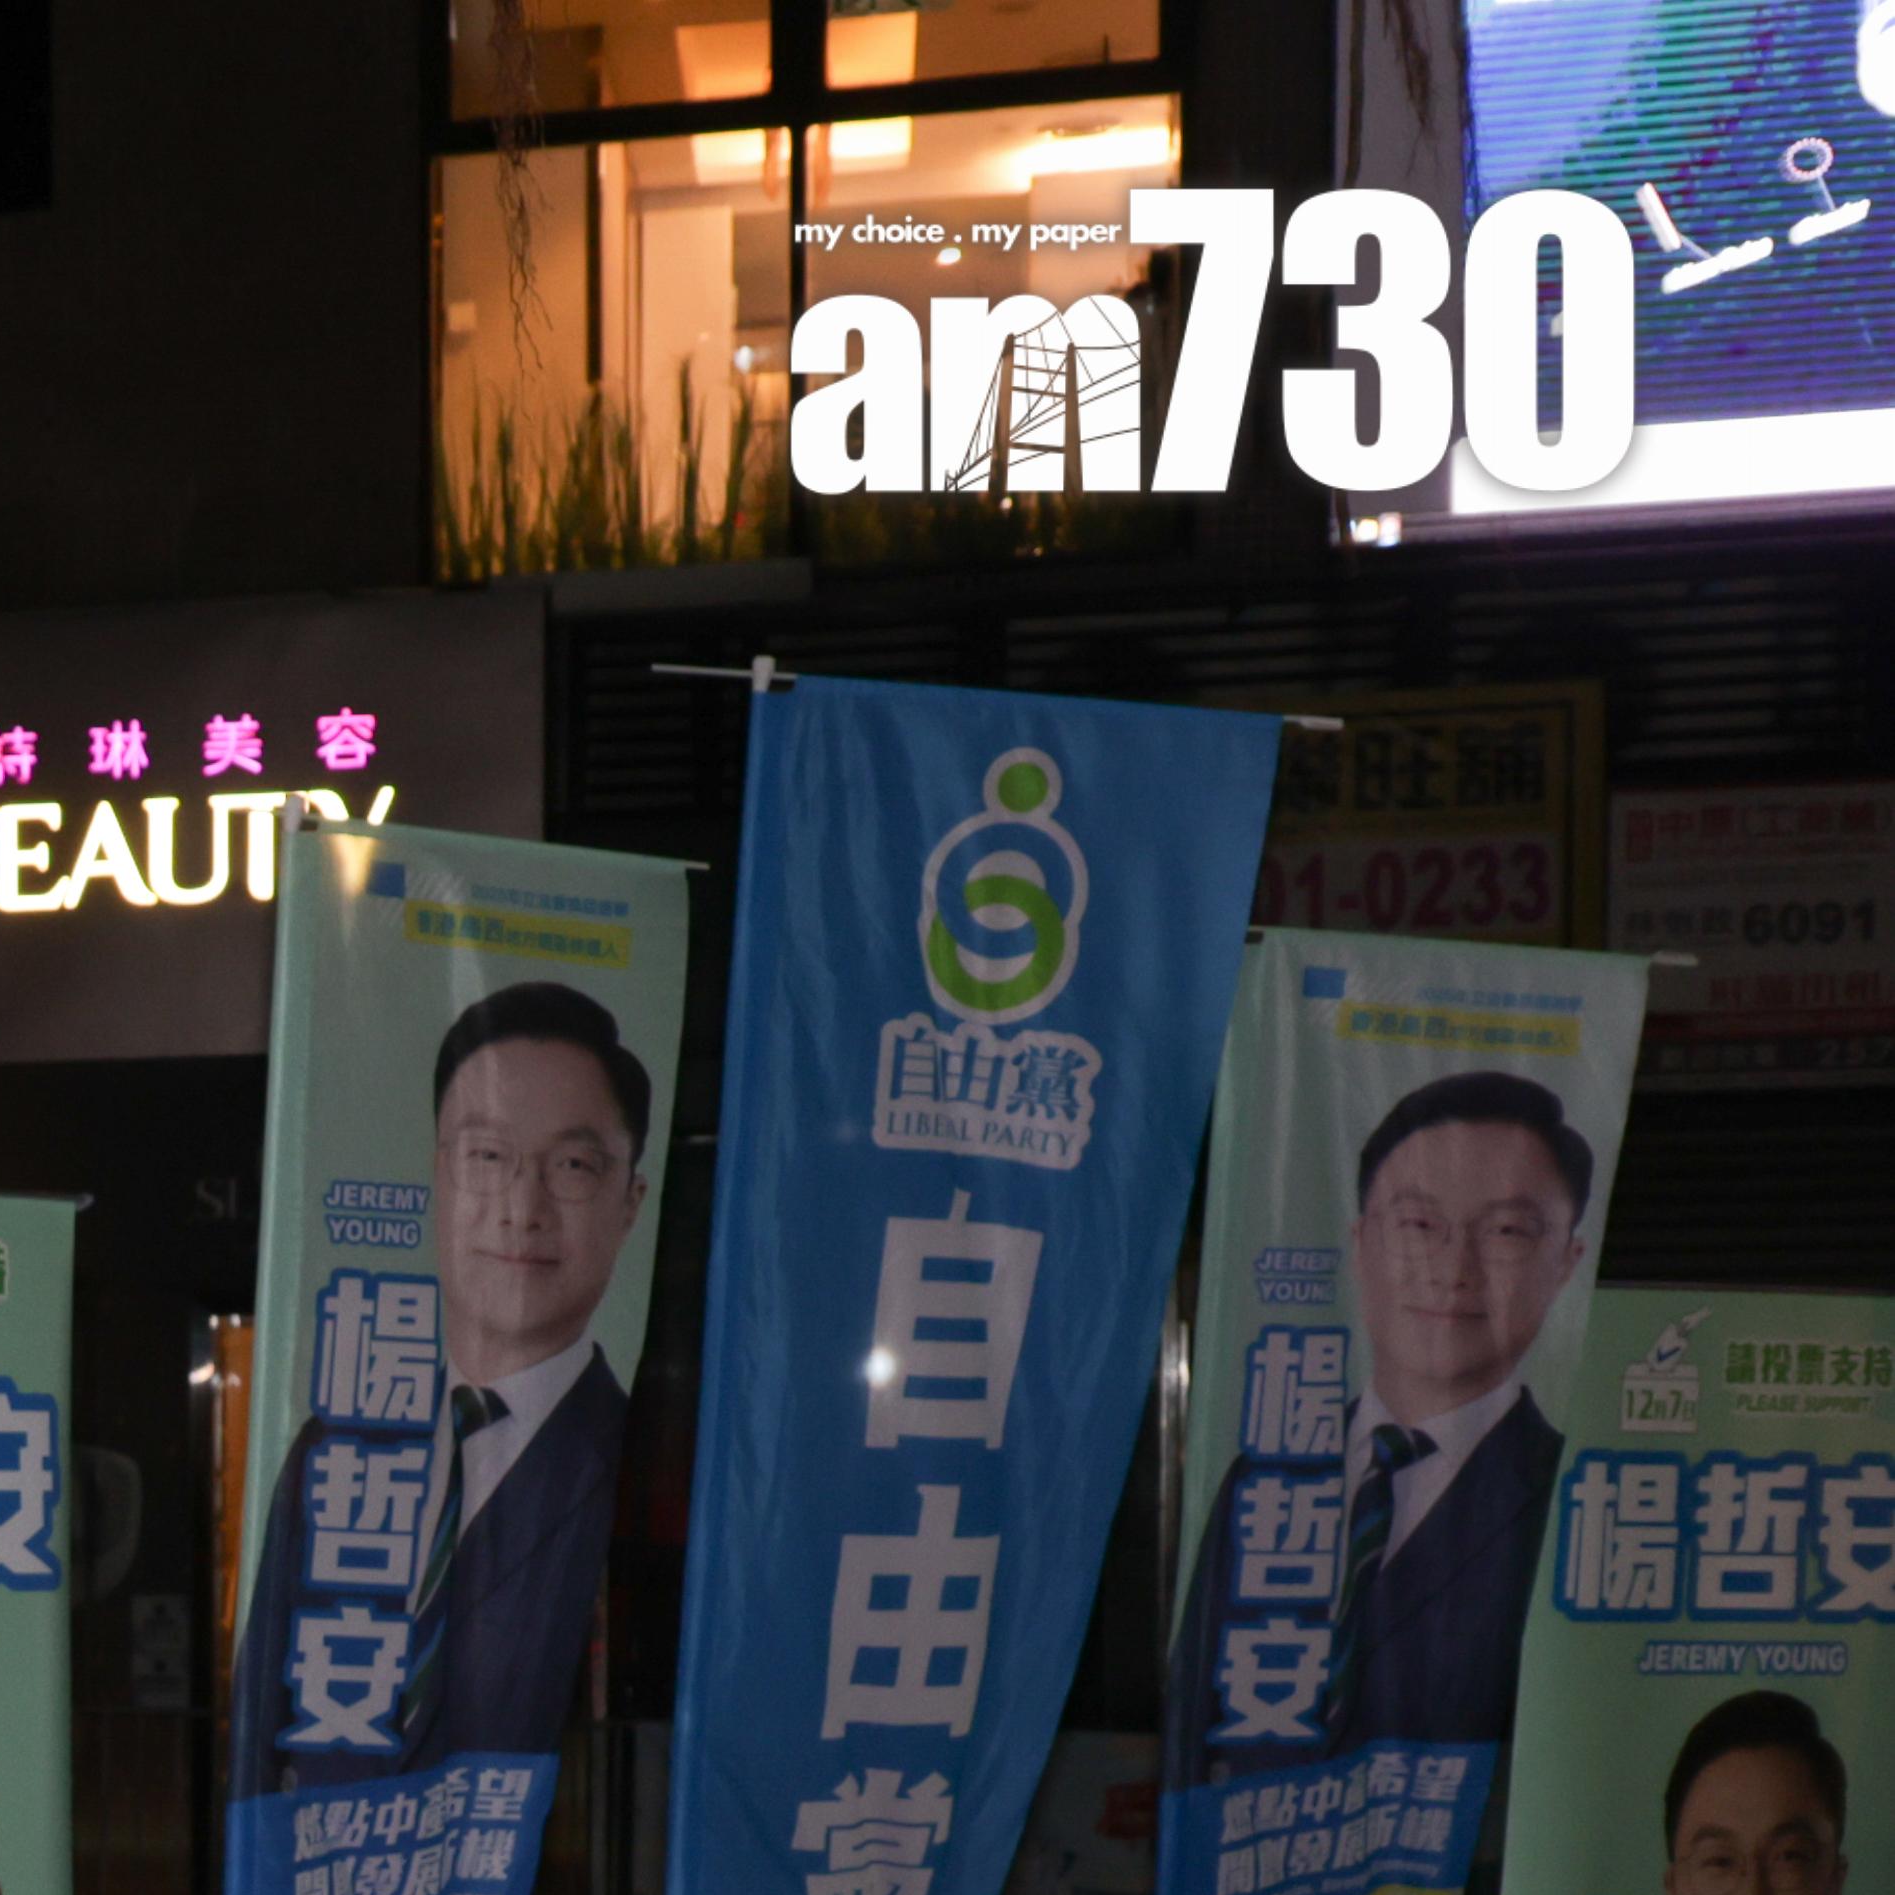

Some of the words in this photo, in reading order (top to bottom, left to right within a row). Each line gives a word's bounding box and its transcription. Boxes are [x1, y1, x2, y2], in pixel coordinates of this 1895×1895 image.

[1742, 896, 1875, 948] 6091
[890, 1027, 1088, 1123] 自由黨
[886, 1109, 969, 1142] LIBEAL
[981, 1121, 1076, 1158] PARTY
[326, 1183, 430, 1212] JEREMY
[329, 1217, 419, 1247] YOUNG
[1726, 1342, 1893, 1387] 請投票支持
[285, 1276, 438, 1747] 楊哲安
[1215, 1330, 1346, 1740] 楊哲安
[1566, 1461, 1895, 1611] 楊哲安
[1640, 1644, 1747, 1672] JEREMY
[1755, 1644, 1846, 1672] YOUNG
